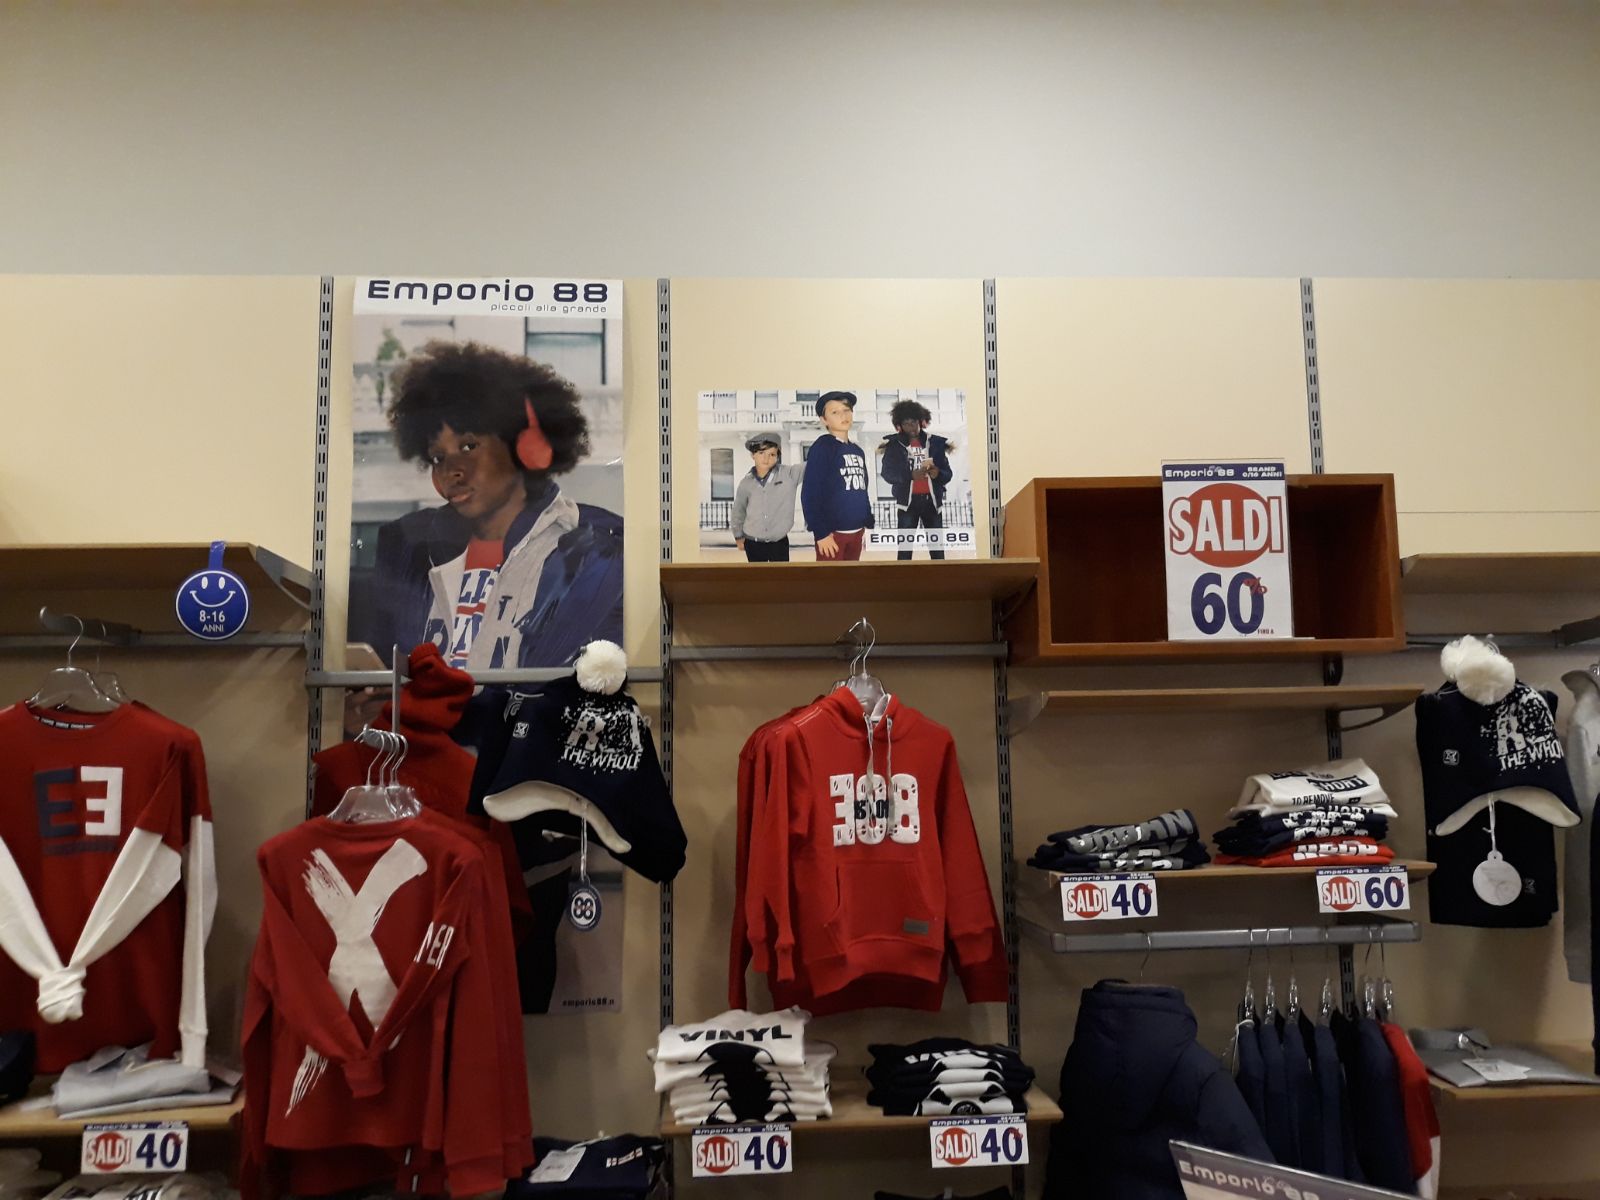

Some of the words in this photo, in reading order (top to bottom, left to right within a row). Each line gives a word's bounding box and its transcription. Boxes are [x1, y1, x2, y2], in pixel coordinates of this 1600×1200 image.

[368, 279, 534, 305] Emporio
[553, 283, 608, 302] 88
[490, 303, 531, 312] piccoli
[562, 305, 607, 314] grande
[1165, 468, 1213, 479] Emporio
[1217, 469, 1235, 477] 88
[1168, 495, 1285, 555] SALDI
[870, 532, 939, 545] Emporio
[946, 532, 970, 543] 88
[199, 609, 226, 623] 8-16
[202, 623, 224, 633] ANNI
[561, 746, 590, 765] THE
[1499, 750, 1527, 771] THE
[1066, 887, 1109, 914] SALDI
[1321, 880, 1362, 907] SALDI
[573, 896, 594, 920] 88
[678, 1023, 793, 1042] VINYL
[86, 1138, 132, 1167] SALDI
[696, 1140, 740, 1169] SALDI
[935, 1132, 978, 1161] SALDI
[1178, 1159, 1276, 1195] Emporio
